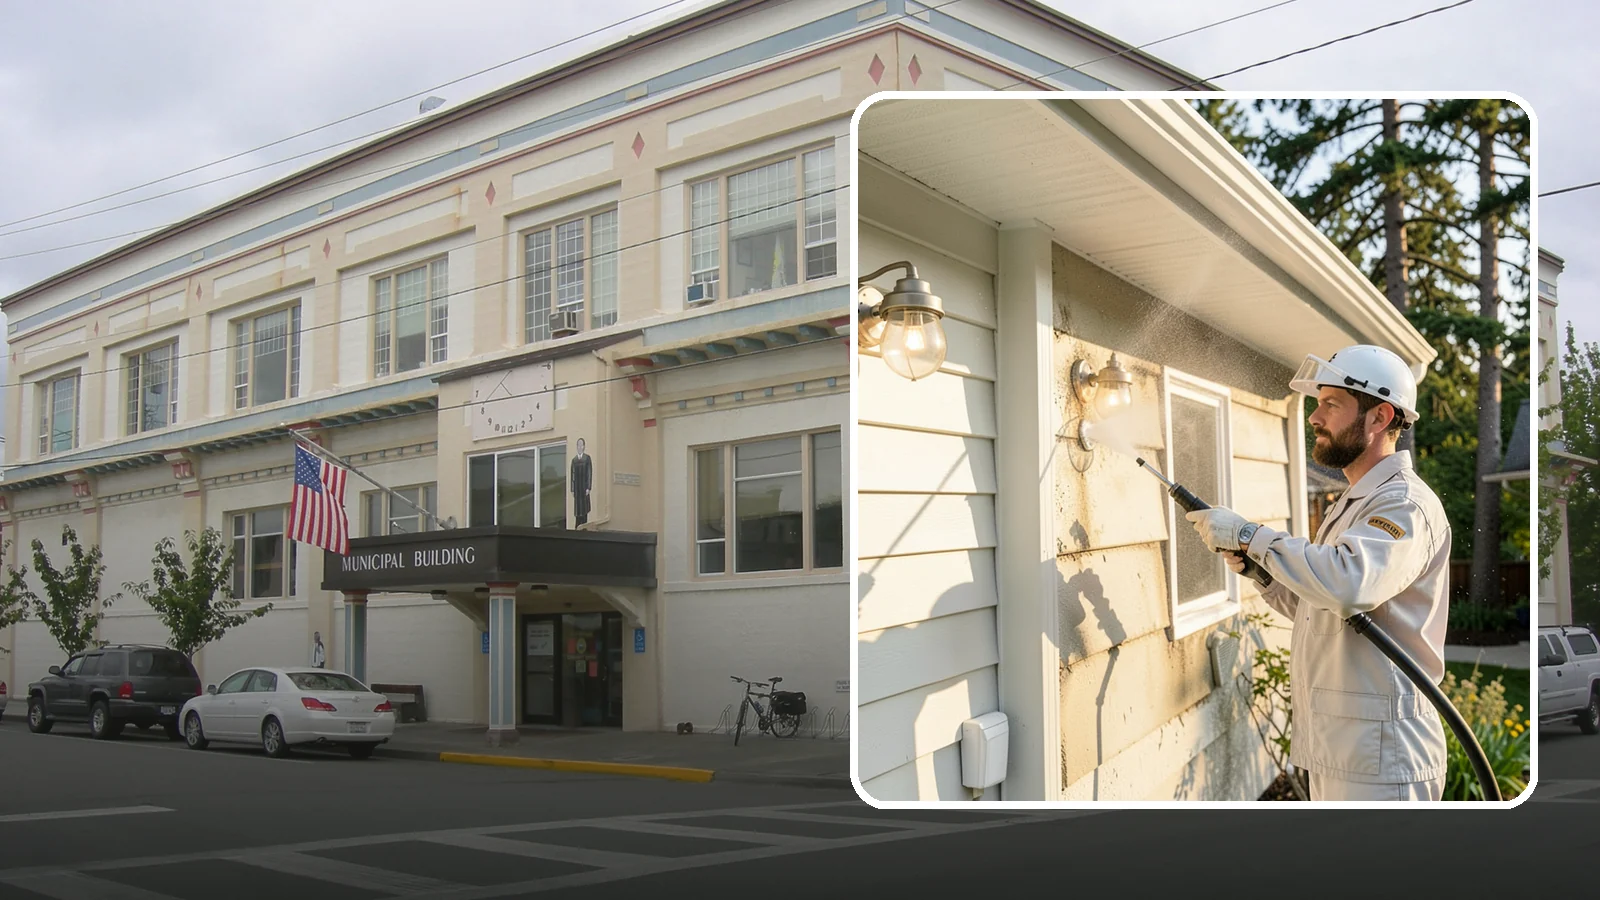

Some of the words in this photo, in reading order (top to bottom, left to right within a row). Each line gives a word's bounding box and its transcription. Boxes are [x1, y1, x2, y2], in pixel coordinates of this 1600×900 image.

[507, 425, 513, 433] 12
[342, 552, 405, 572] MUNICIPAL
[414, 546, 475, 567] BUILDING
